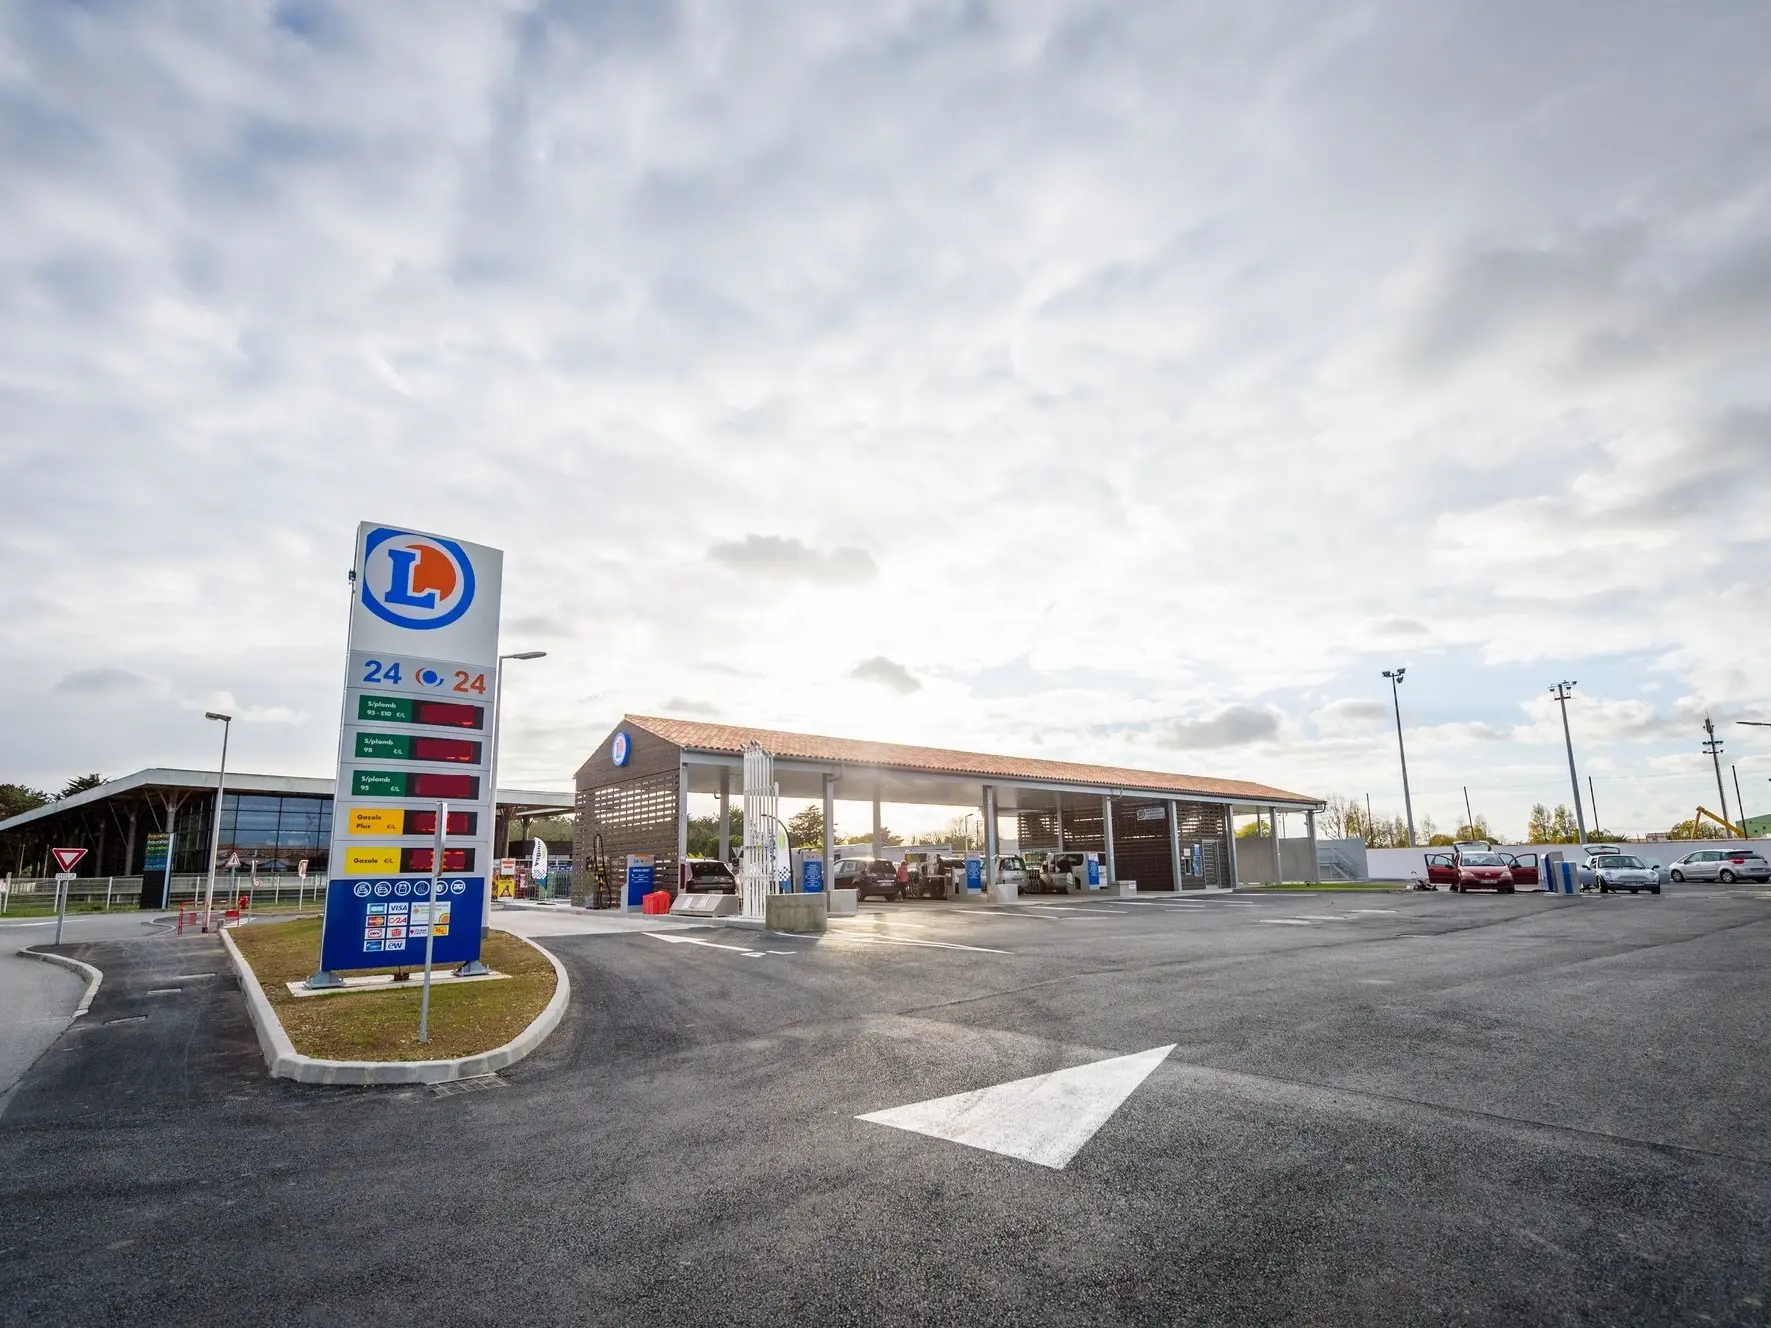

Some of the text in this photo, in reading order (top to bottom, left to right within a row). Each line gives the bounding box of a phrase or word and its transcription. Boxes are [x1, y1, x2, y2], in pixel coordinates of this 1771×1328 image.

[384, 548, 436, 610] L
[363, 660, 486, 695] 24 24
[367, 701, 397, 709] S/plomb
[364, 738, 394, 746] S/plomb
[361, 775, 391, 783] S/plomb
